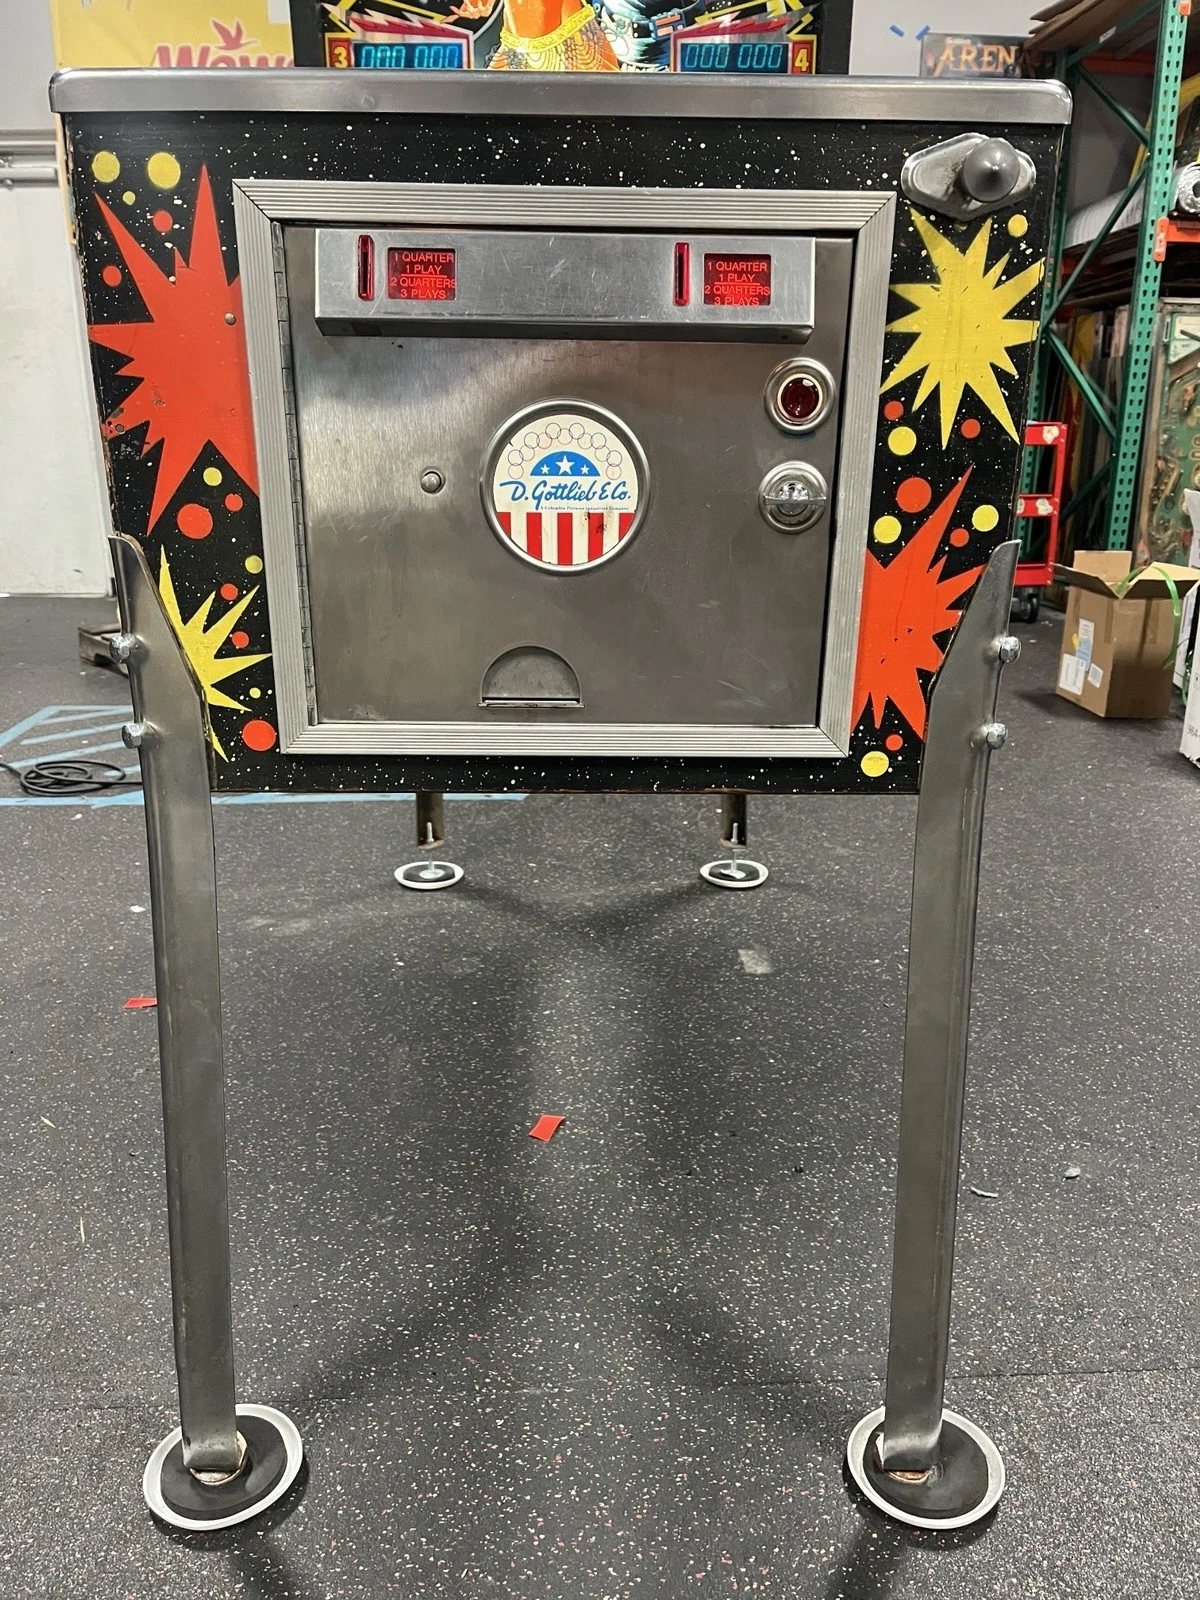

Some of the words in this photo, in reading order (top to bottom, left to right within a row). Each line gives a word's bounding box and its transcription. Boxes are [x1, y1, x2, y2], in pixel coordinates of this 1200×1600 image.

[333, 46, 348, 68] 3
[794, 48, 809, 72] 4
[394, 252, 399, 262] 1
[402, 252, 454, 263] QUARTER
[406, 265, 411, 274] 1
[414, 265, 442, 275] PLAY
[708, 262, 713, 271] 1
[716, 262, 767, 272] QUARTER
[390, 278, 397, 287] 2
[400, 278, 456, 289] QUARTERS
[728, 274, 755, 283] PLAY
[400, 290, 408, 299] 3
[411, 290, 446, 300] PLAYS
[704, 285, 711, 295] 2
[713, 286, 771, 296] QUARTERS
[714, 297, 721, 305] 3
[725, 297, 759, 306] PLAYS
[499, 480, 529, 502] D.
[531, 479, 598, 511] Gottlieb
